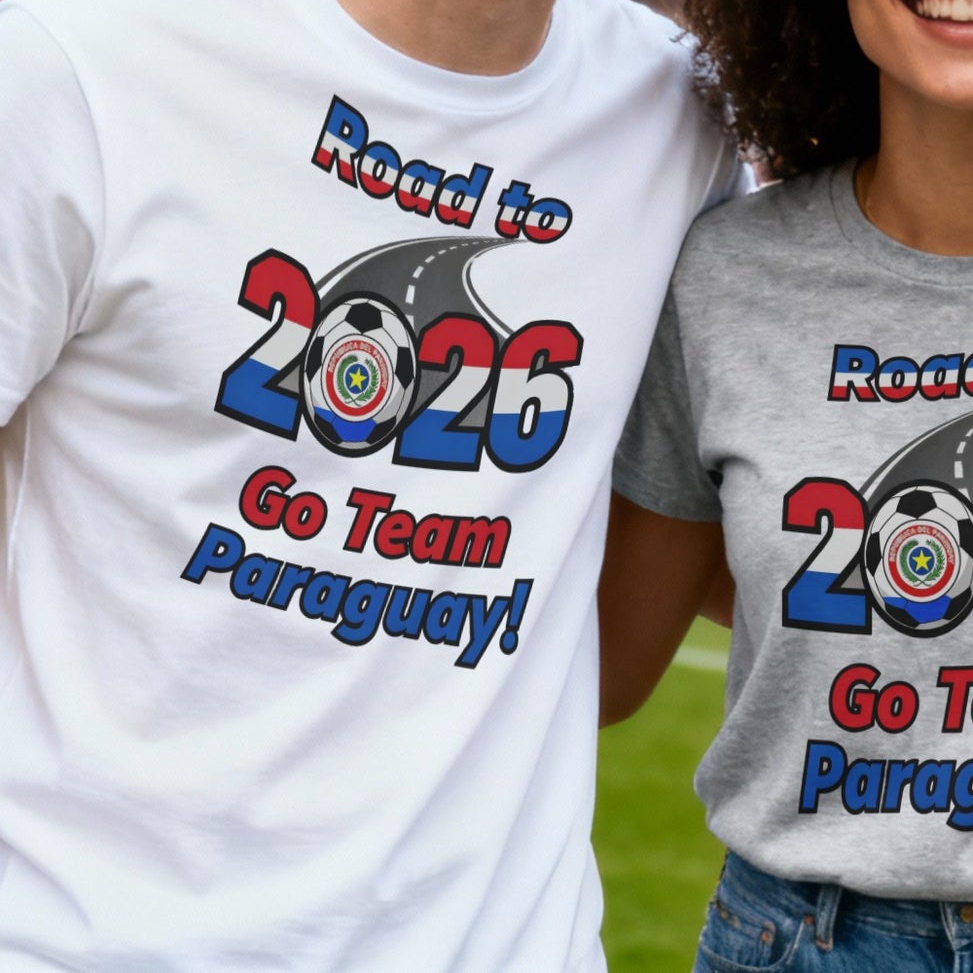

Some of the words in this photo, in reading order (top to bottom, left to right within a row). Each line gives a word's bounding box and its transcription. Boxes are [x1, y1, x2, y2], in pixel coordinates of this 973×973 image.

[311, 94, 494, 228] Road
[496, 180, 573, 243] to
[239, 465, 328, 539] Go
[343, 488, 511, 568] Team
[180, 523, 534, 669] Paraguay!
[829, 663, 919, 733] Go
